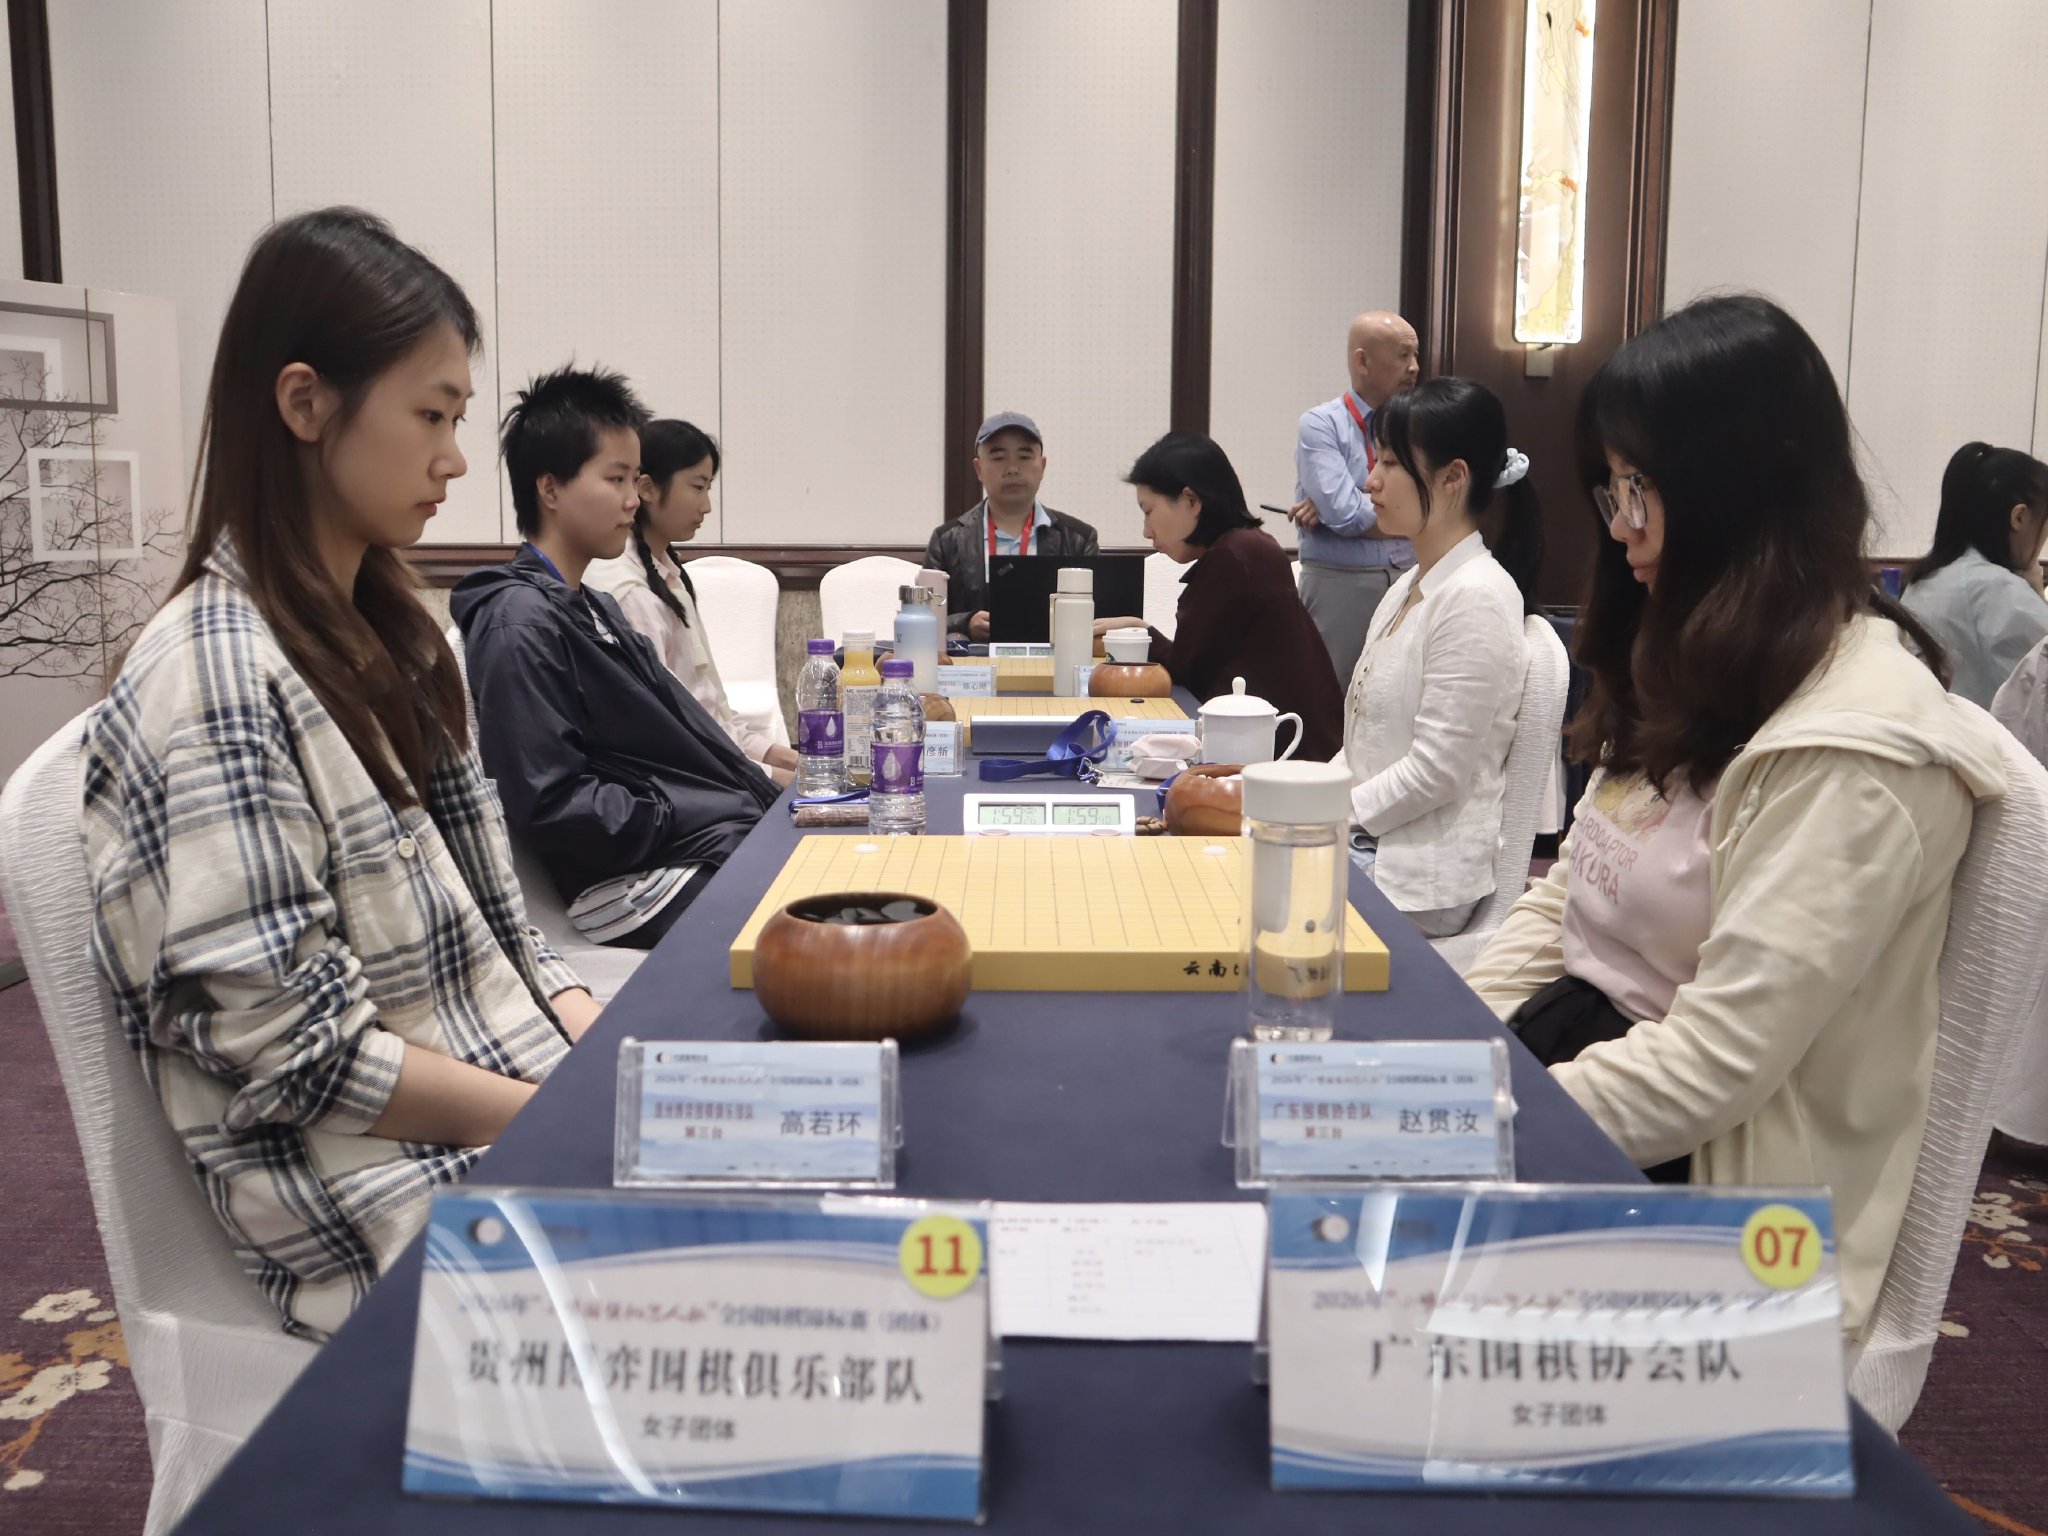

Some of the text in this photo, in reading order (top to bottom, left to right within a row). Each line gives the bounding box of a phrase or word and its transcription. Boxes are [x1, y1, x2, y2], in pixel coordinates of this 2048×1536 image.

[1182, 959, 1240, 978] 云南
[780, 1110, 862, 1136] 高若环
[1398, 1108, 1480, 1134] 赵贯汝
[914, 1234, 967, 1276] 11
[1755, 1226, 1808, 1268] 07
[1369, 1335, 1742, 1383] 广东围棋协会队
[640, 1413, 736, 1442] 女子团体
[1511, 1401, 1608, 1427] 女子团体
